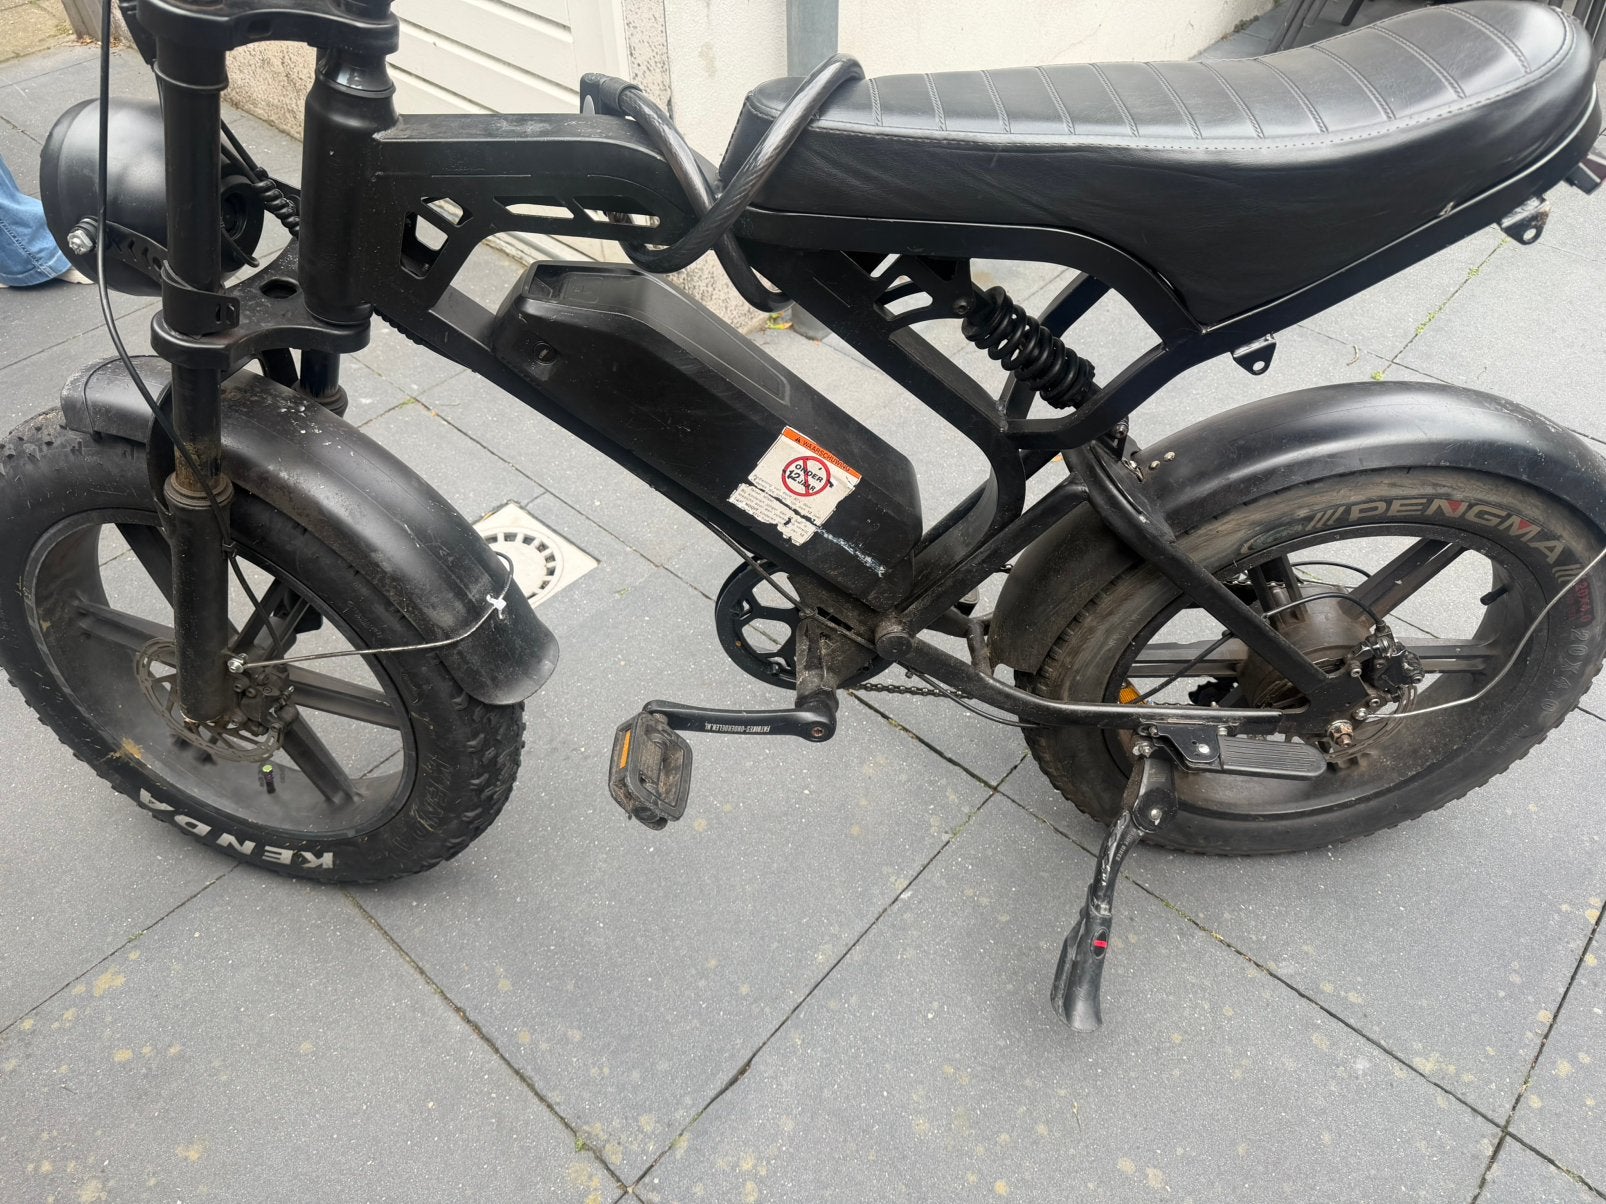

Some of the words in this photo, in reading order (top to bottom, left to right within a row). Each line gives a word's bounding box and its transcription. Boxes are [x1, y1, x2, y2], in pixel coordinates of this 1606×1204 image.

[794, 463, 824, 483] ONDER
[802, 440, 851, 473] WAARSCHUWING
[787, 469, 801, 482] 12
[1349, 499, 1566, 564] PENGMA
[139, 787, 334, 870] KENDA
